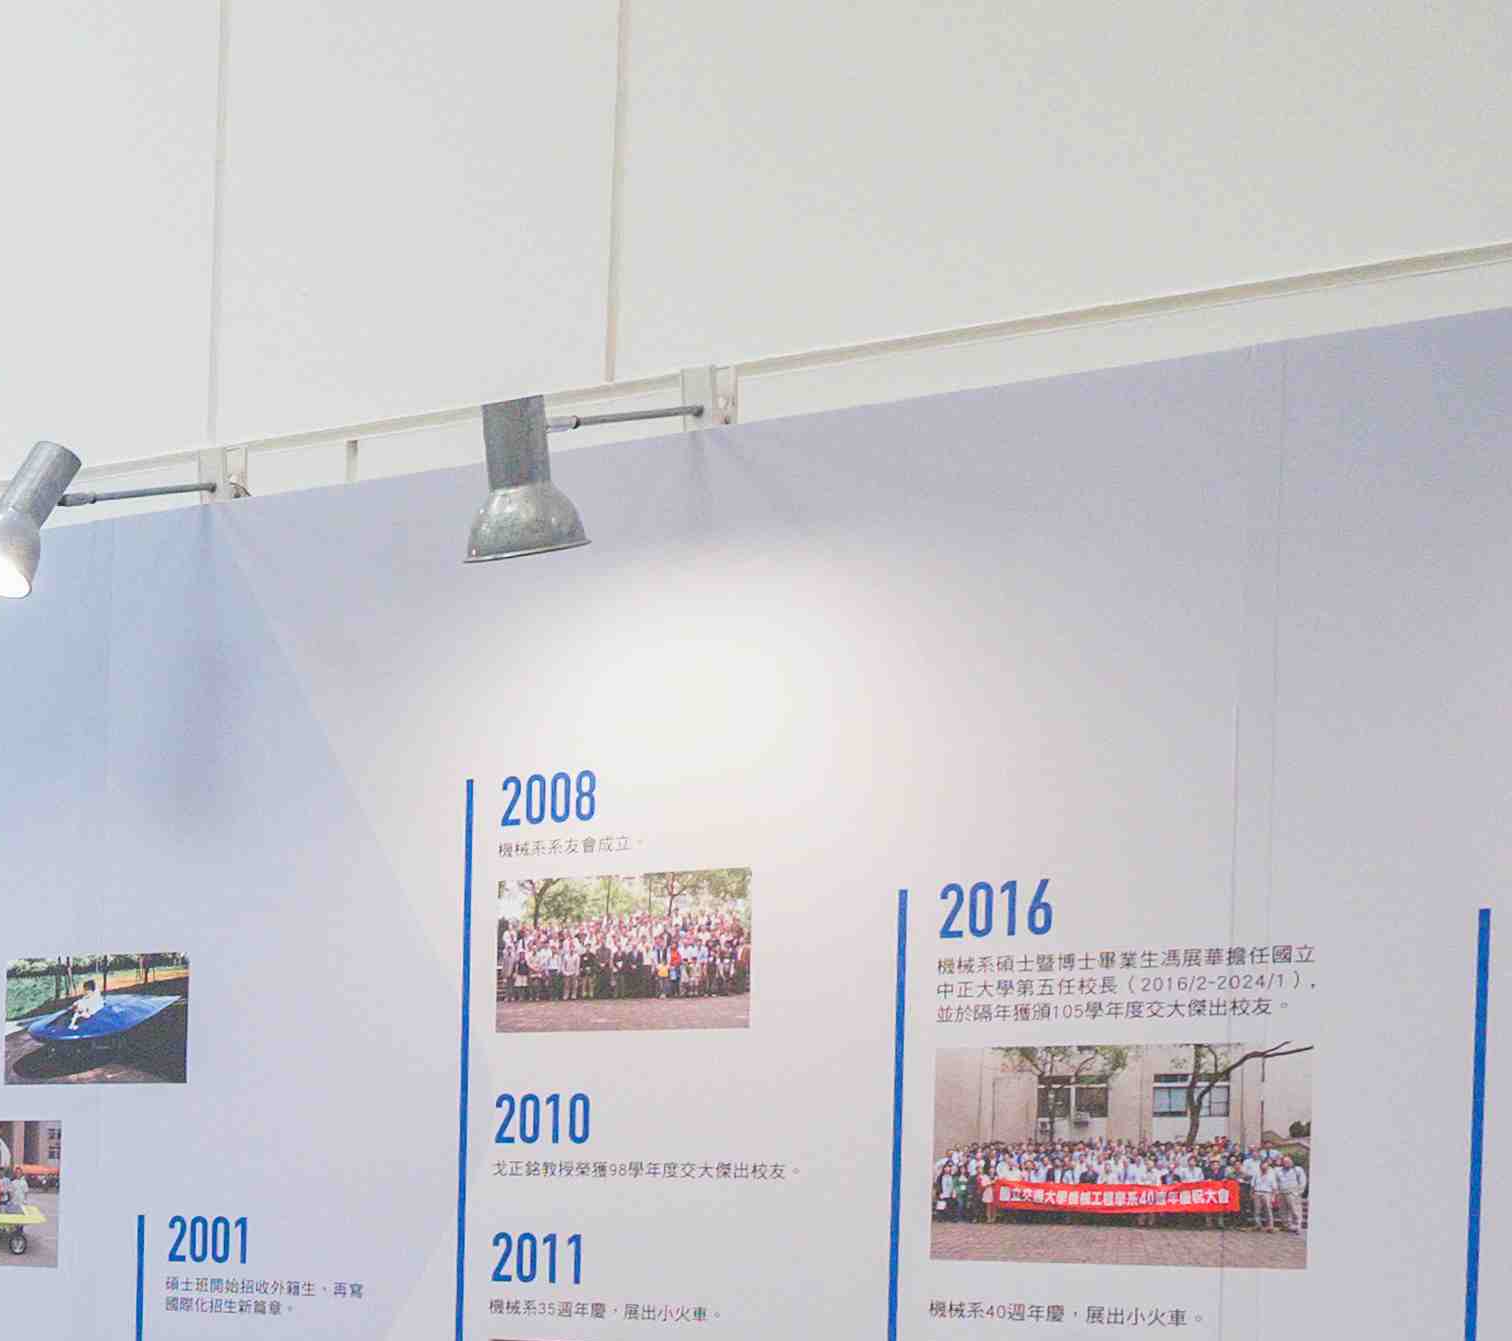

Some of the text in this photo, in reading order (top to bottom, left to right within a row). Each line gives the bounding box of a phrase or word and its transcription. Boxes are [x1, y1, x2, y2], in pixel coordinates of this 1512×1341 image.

[500, 769, 597, 827] 2008
[939, 878, 1054, 939] 2016
[494, 1092, 590, 1144] 2010
[167, 1215, 249, 1264] 2001
[491, 1231, 584, 1285] 2011
